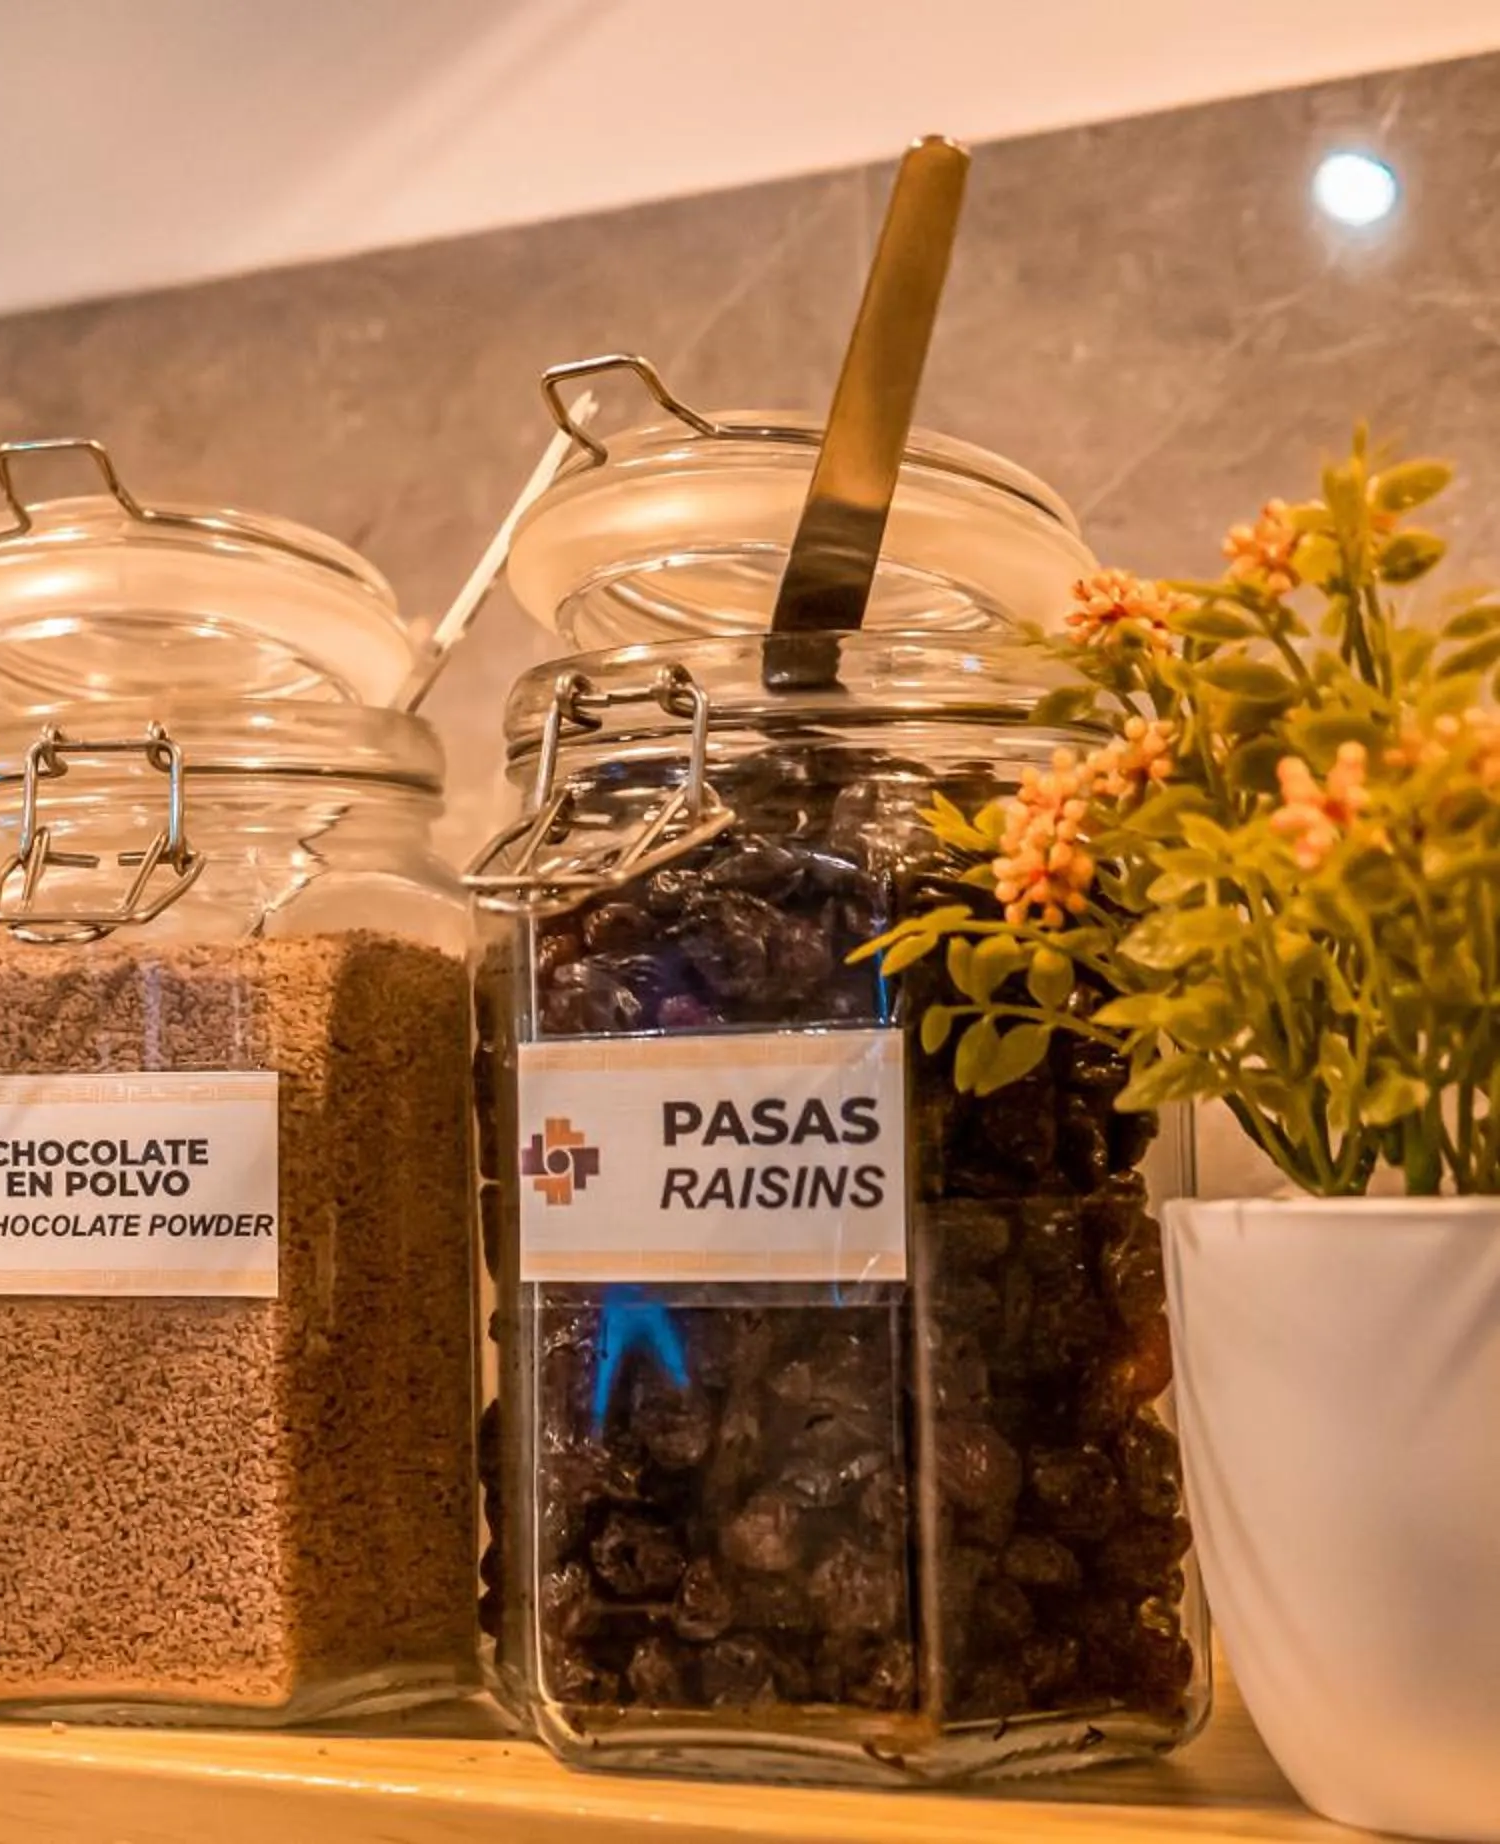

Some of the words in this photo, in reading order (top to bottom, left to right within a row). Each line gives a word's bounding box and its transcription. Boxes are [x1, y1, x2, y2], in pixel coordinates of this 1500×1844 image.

[663, 1097, 880, 1146] PASAS
[6, 1171, 53, 1197] EN
[65, 1170, 190, 1198] POLVO
[660, 1165, 885, 1210] RAISINS
[148, 1214, 274, 1238] POWDER
